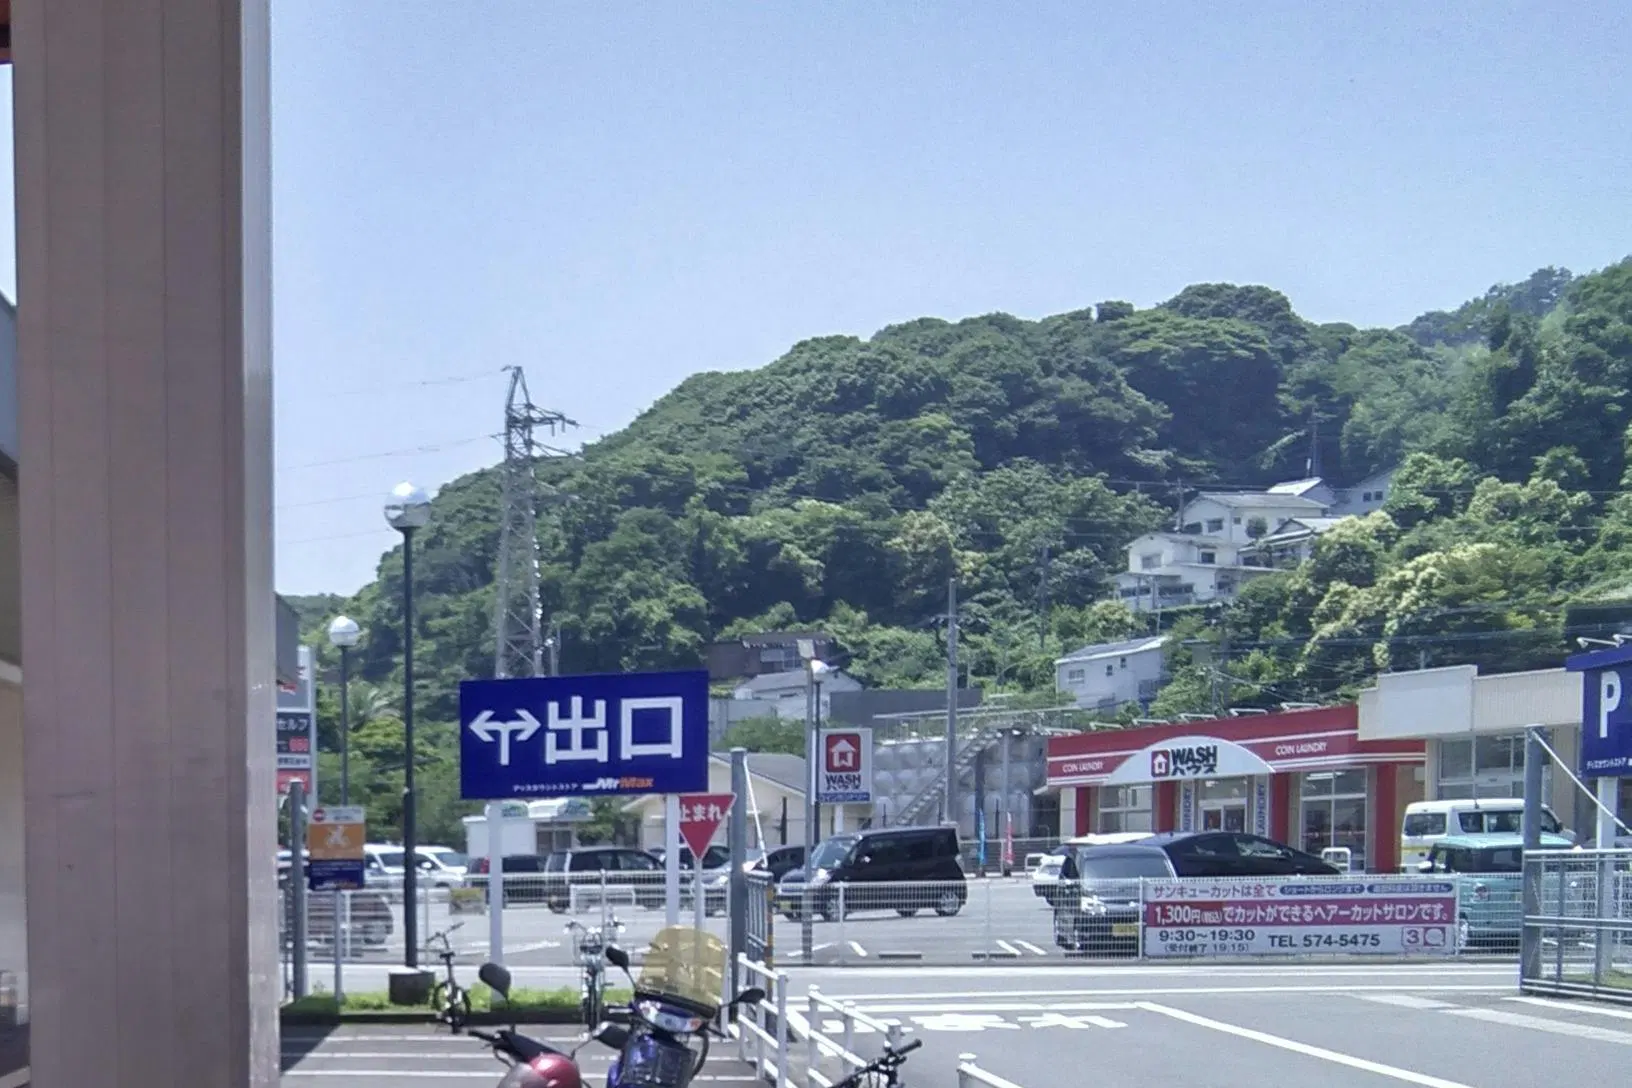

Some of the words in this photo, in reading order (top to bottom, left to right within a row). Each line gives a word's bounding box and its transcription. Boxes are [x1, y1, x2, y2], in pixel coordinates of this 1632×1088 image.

[1599, 671, 1622, 738] P
[545, 696, 683, 764] 出口
[1171, 745, 1218, 766] WASH
[1275, 745, 1295, 756] COIN
[1296, 742, 1327, 754] LAUNDRY
[1171, 764, 1218, 776] ハウス
[582, 777, 654, 791] MrMax
[825, 774, 861, 784] WASH
[679, 803, 722, 823] 止まれ
[1183, 787, 1192, 832] AUNDRY
[1154, 884, 1277, 898] サンキューカットは全て
[1268, 935, 1298, 948] TEL
[1302, 934, 1381, 947] 574-5475
